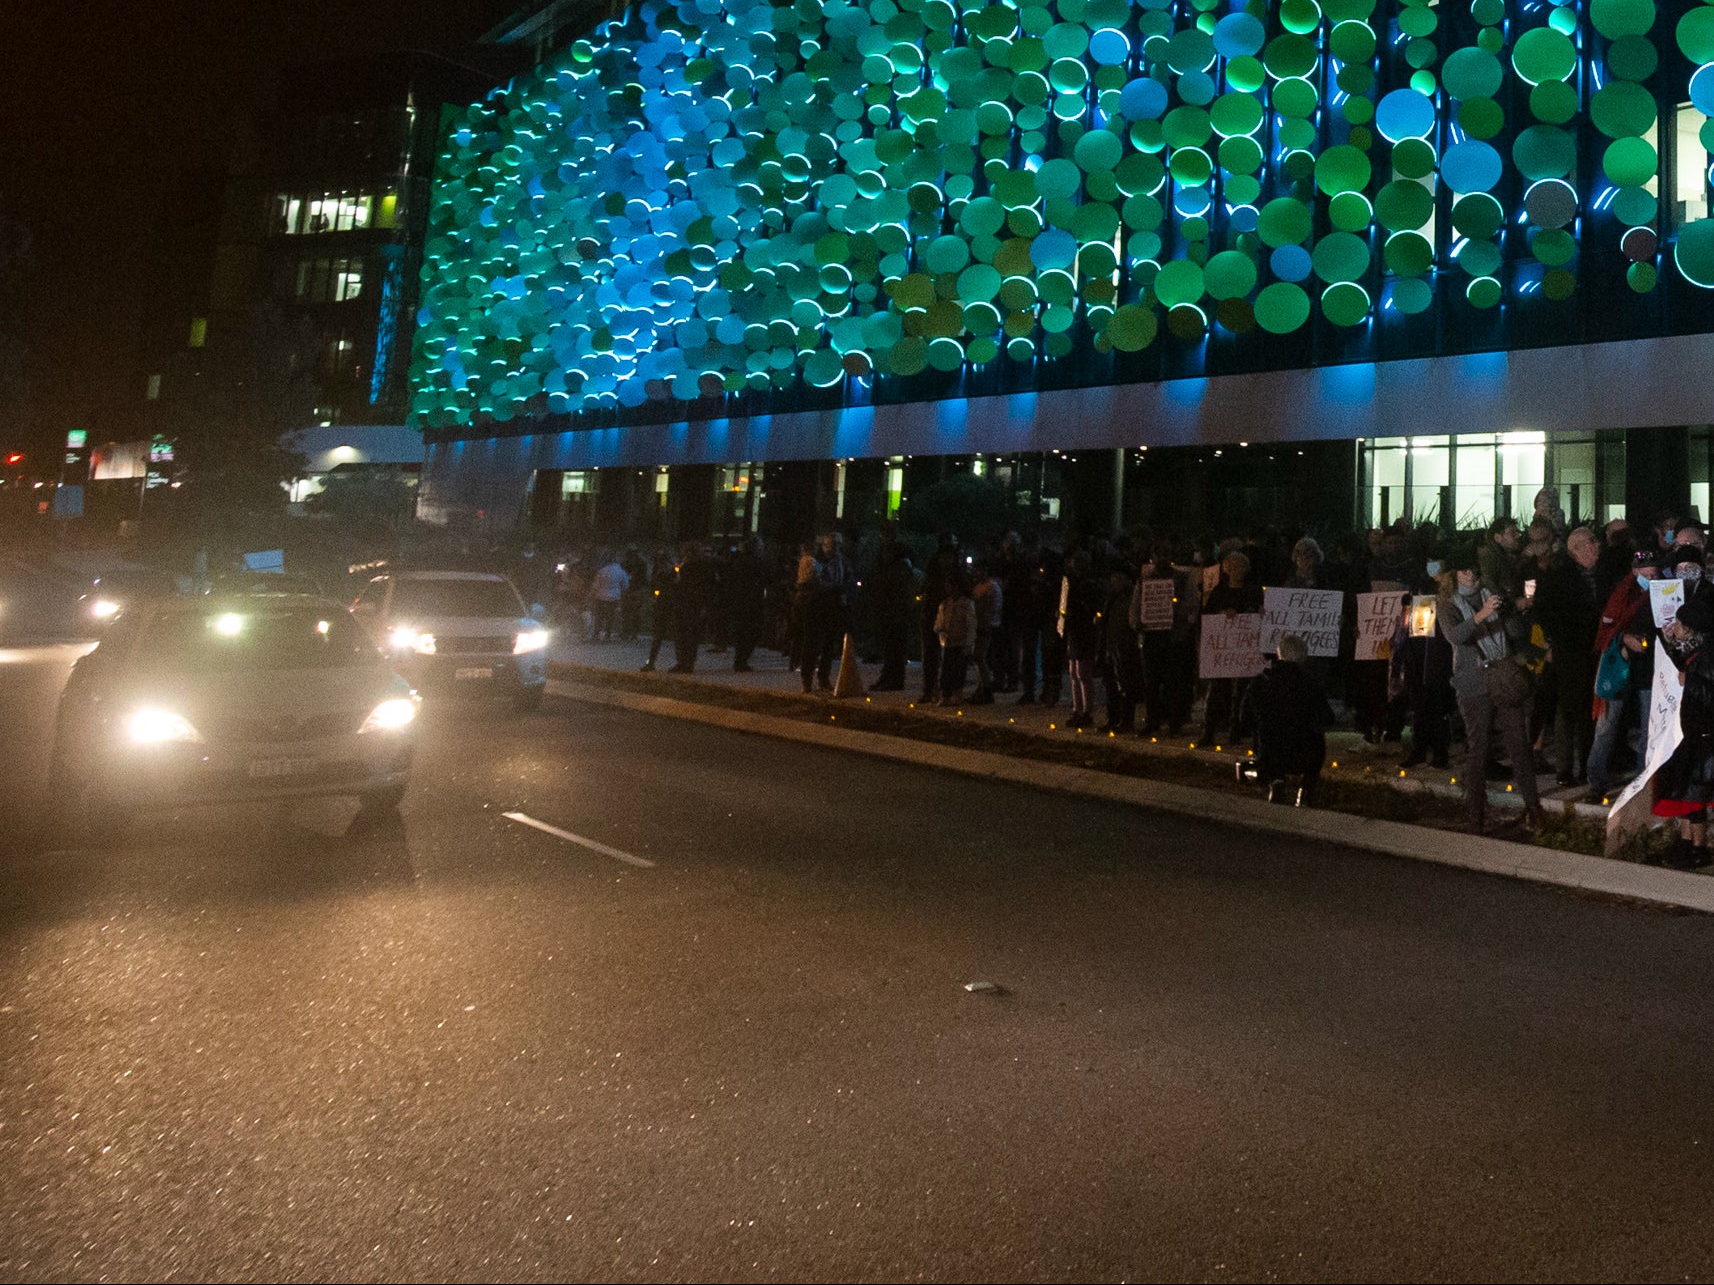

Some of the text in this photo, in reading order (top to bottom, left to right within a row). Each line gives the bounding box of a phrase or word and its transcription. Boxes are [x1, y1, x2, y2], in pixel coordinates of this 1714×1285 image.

[1288, 592, 1332, 609] FREE
[1373, 595, 1398, 616] LET
[1236, 632, 1261, 649] TAM
[1269, 629, 1340, 652] REUGEES
